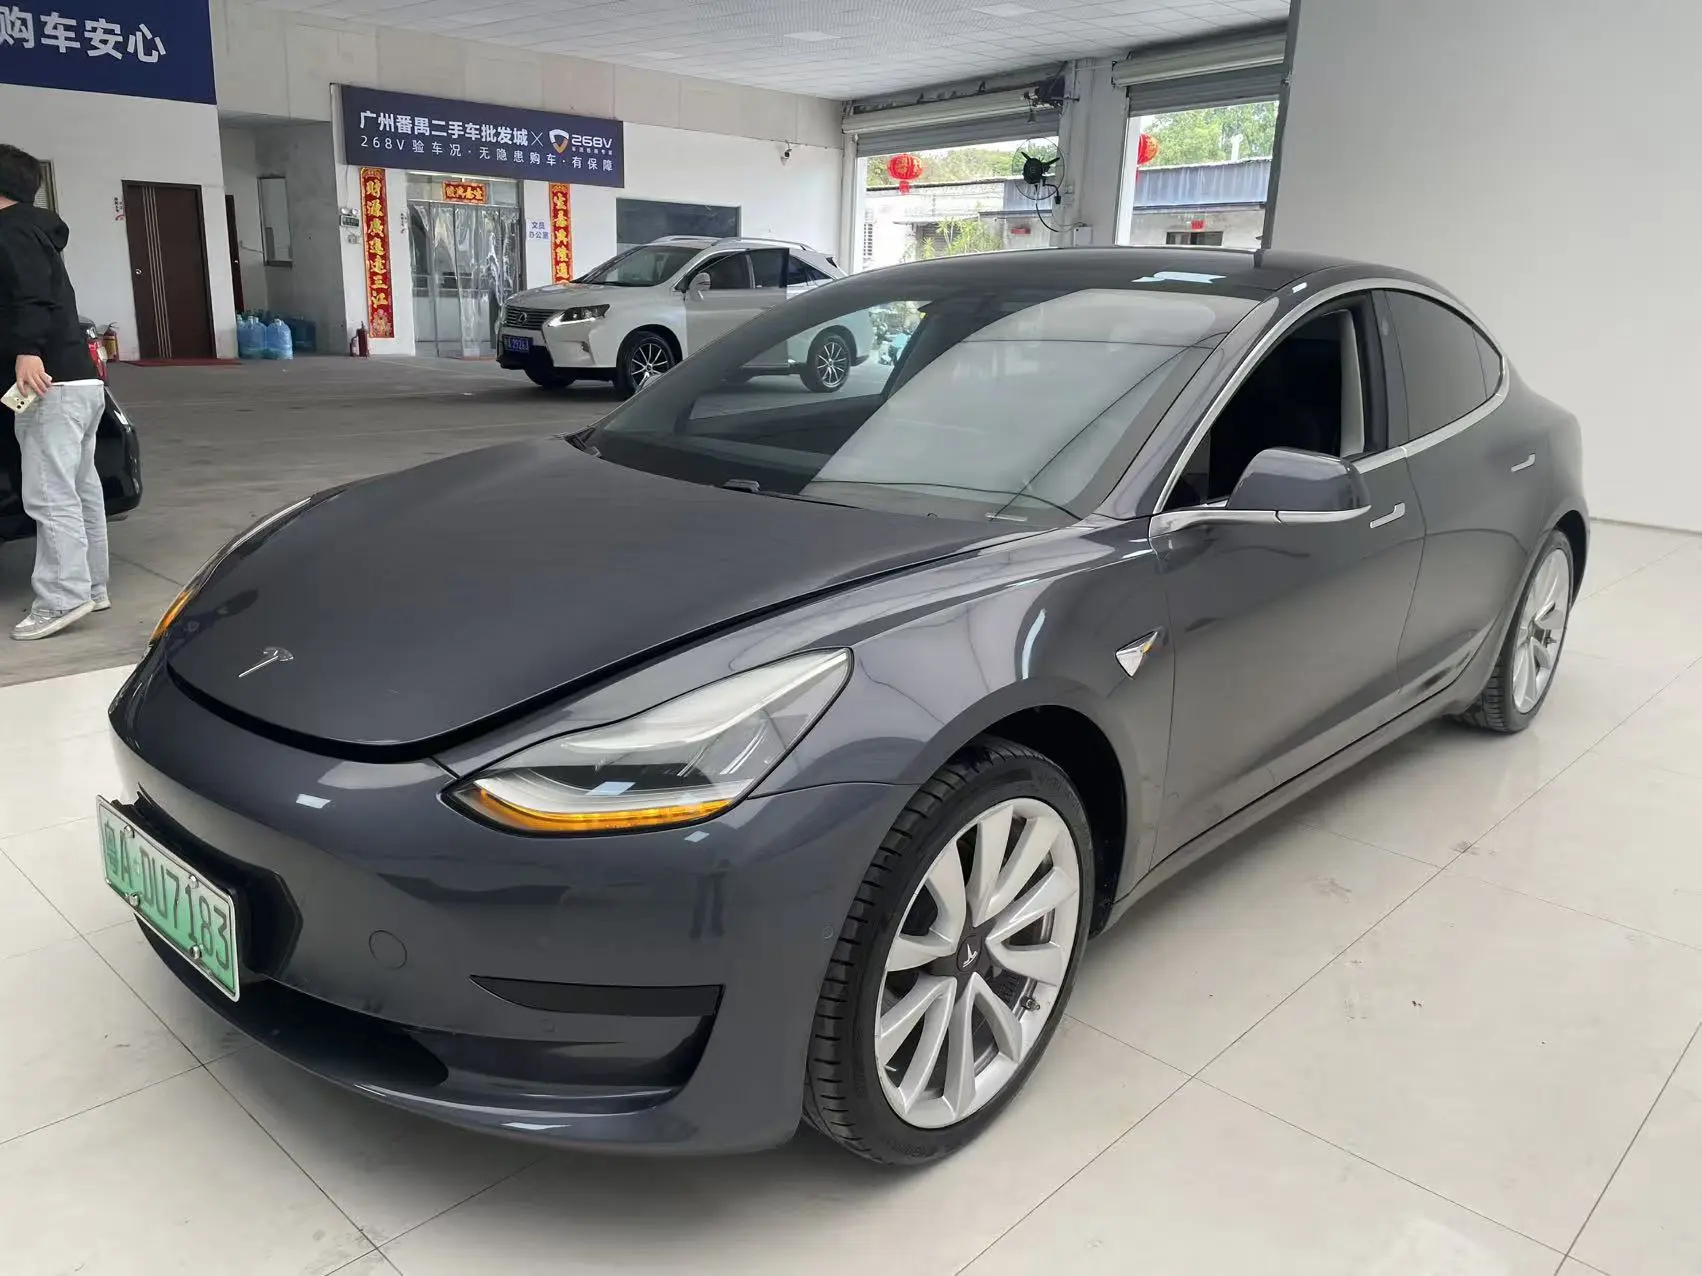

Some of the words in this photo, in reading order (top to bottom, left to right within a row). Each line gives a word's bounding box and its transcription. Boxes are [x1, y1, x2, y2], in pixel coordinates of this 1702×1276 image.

[0, 6, 166, 63] 购车安心
[360, 110, 528, 146] 广州番禺二手车批发城
[571, 134, 612, 148] 268V
